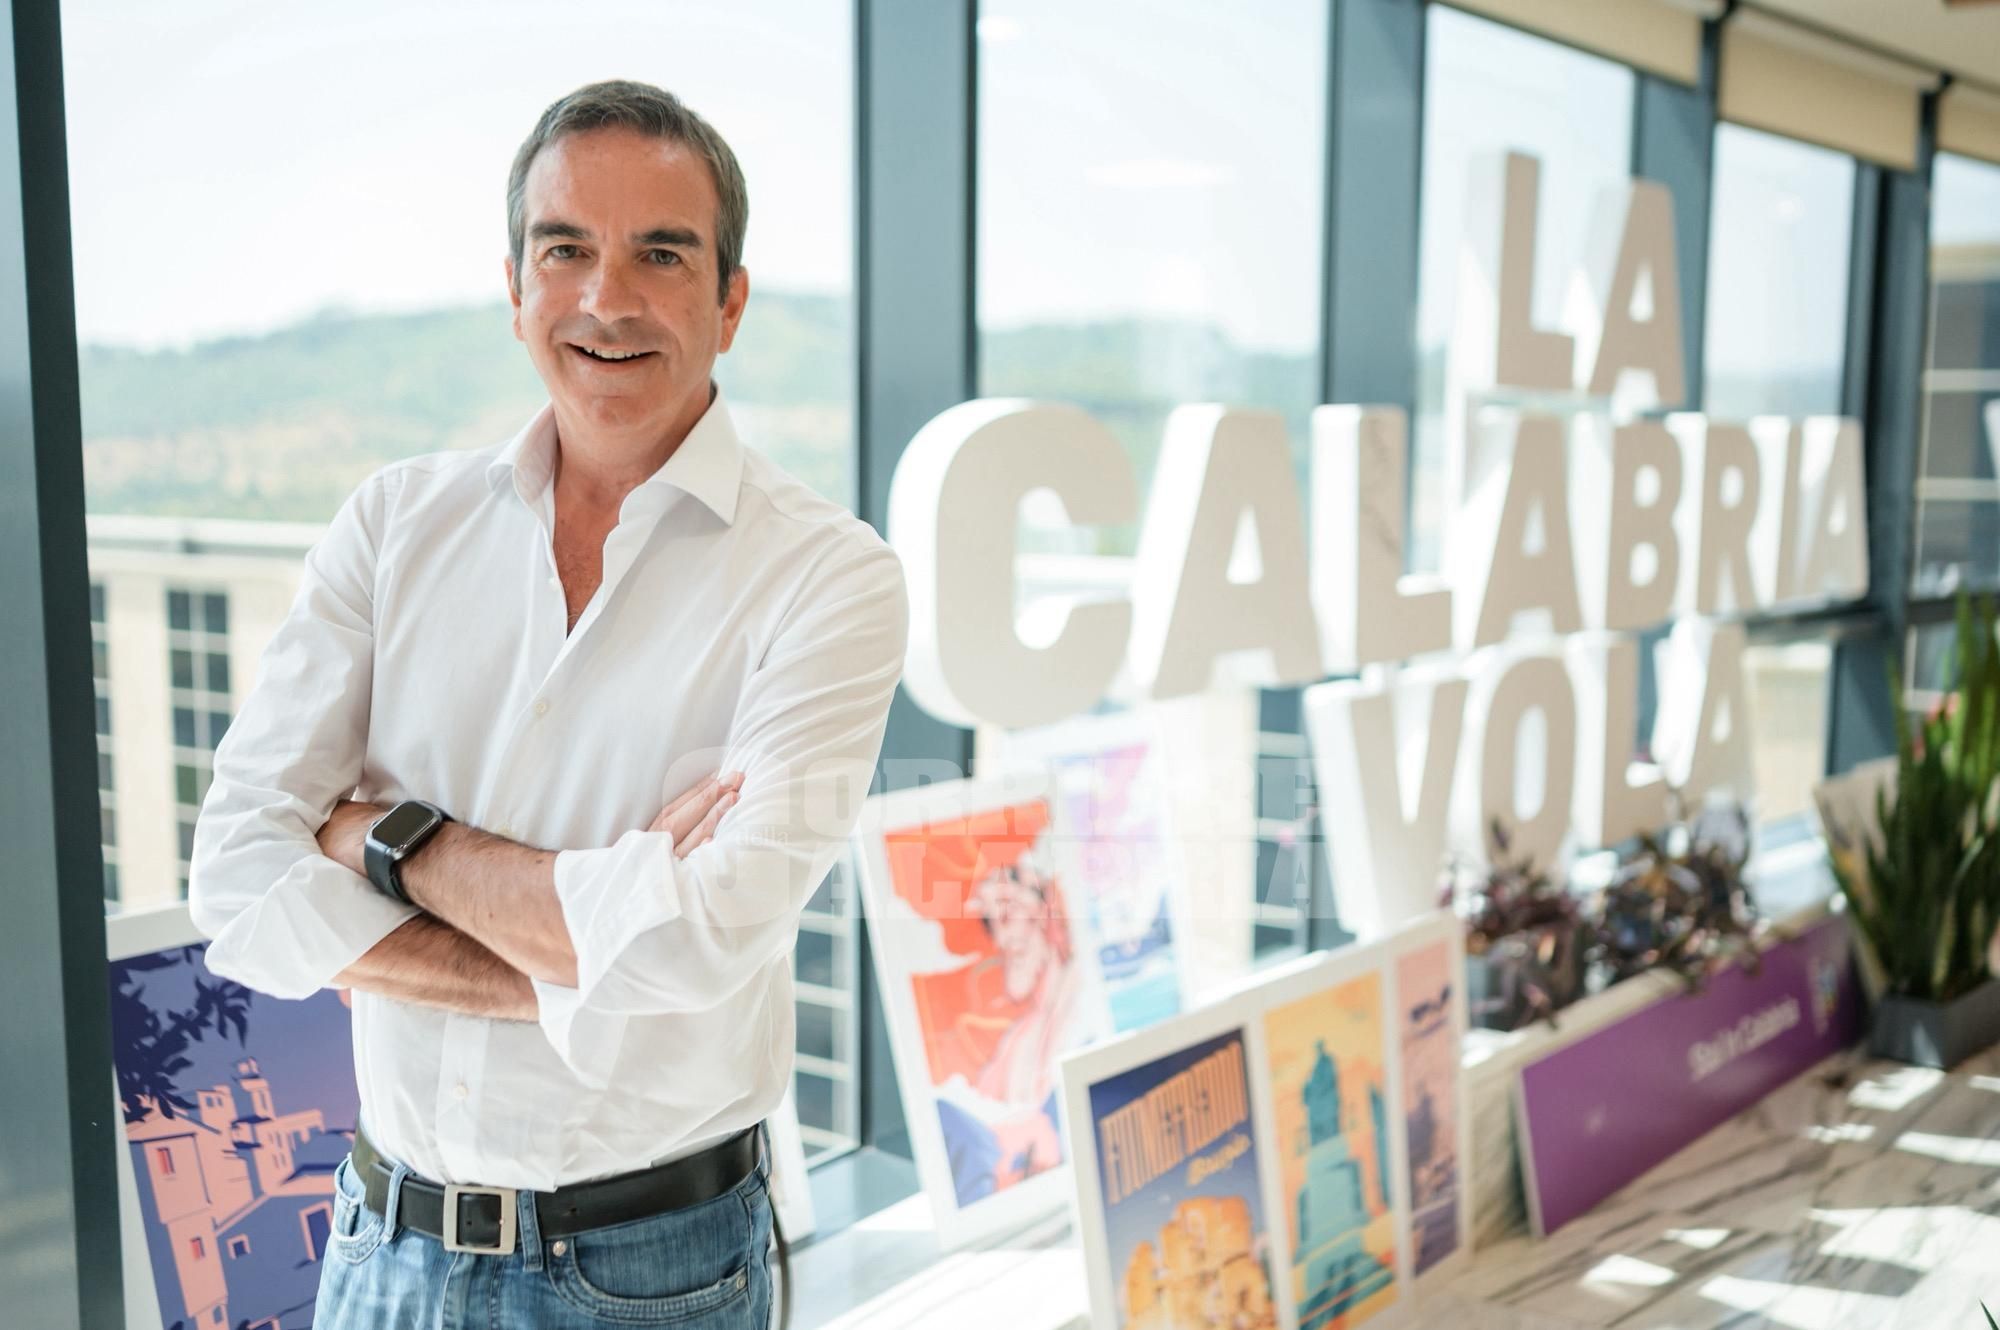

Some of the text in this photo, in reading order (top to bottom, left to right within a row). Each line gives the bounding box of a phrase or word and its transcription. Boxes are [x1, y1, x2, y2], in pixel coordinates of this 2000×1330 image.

[1478, 150, 1687, 406] LA
[889, 398, 1870, 729] CALABRIA
[1312, 617, 1754, 932] VOLA
